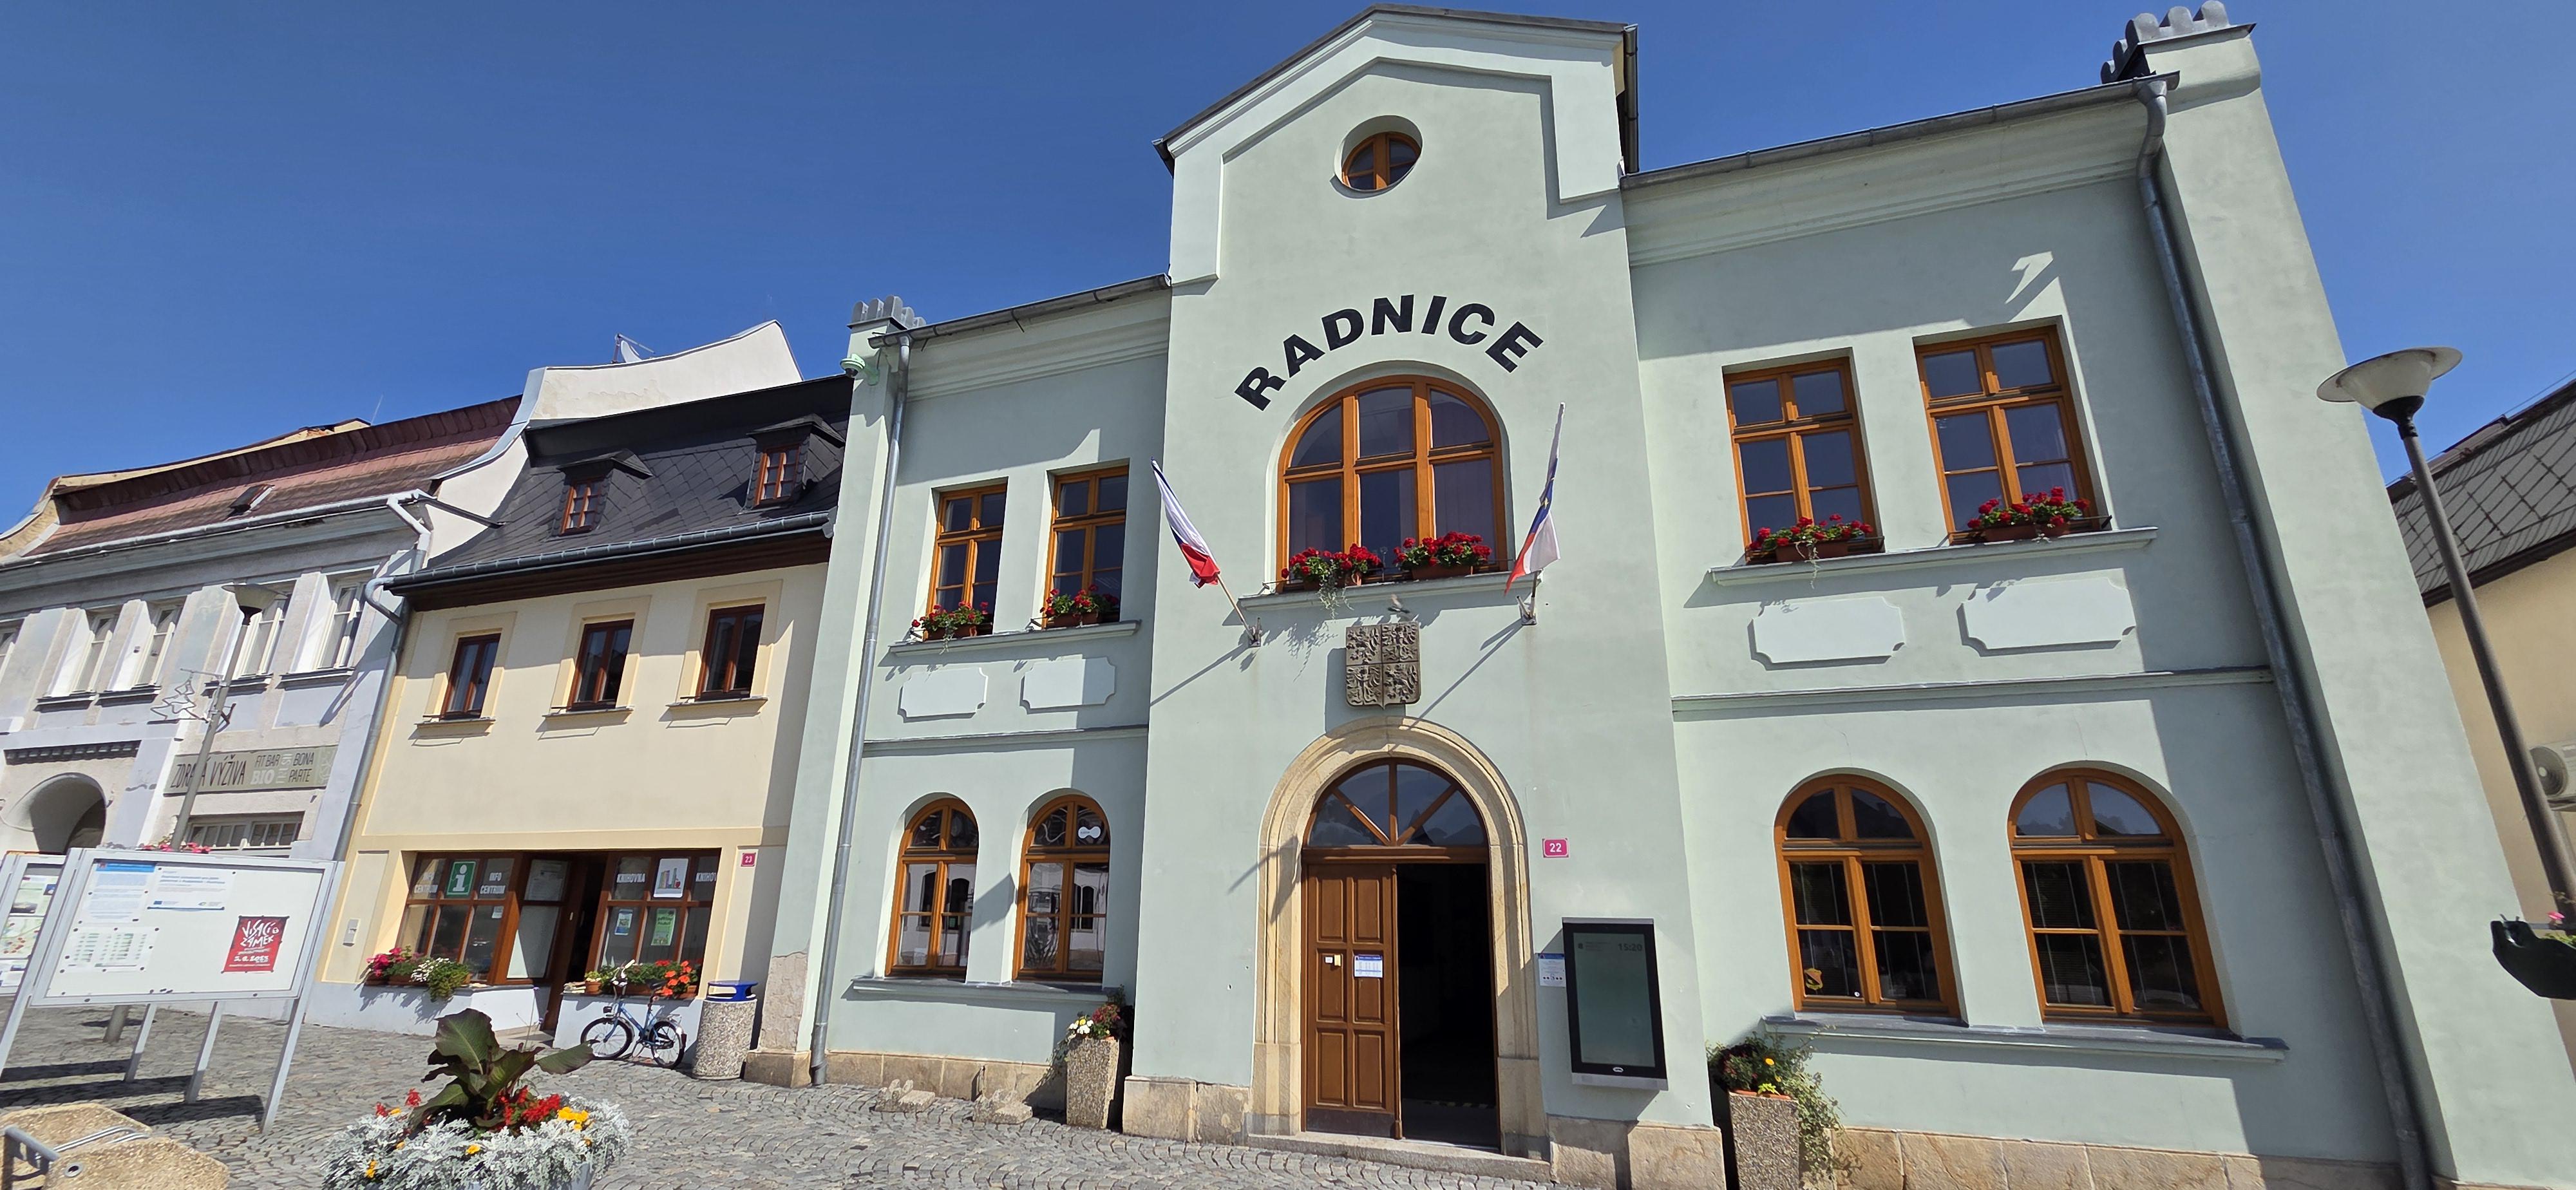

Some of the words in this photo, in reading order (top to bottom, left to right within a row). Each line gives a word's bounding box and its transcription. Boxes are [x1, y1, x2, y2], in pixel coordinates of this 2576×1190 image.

[1234, 294, 1544, 411] RADNICE
[265, 754, 281, 767] BAR
[293, 752, 314, 766] BONA
[170, 757, 211, 788] ZDRAÁ
[210, 754, 247, 786] VÝŽIVA
[250, 769, 275, 784] BIO
[288, 768, 312, 783] PARTE
[1549, 842, 1562, 853] 22
[744, 855, 753, 864] 23
[489, 872, 502, 882] INFO
[616, 873, 645, 883] KNIHOVNA
[480, 885, 506, 894] CENTRUM
[1618, 943, 1642, 952] 15:20
